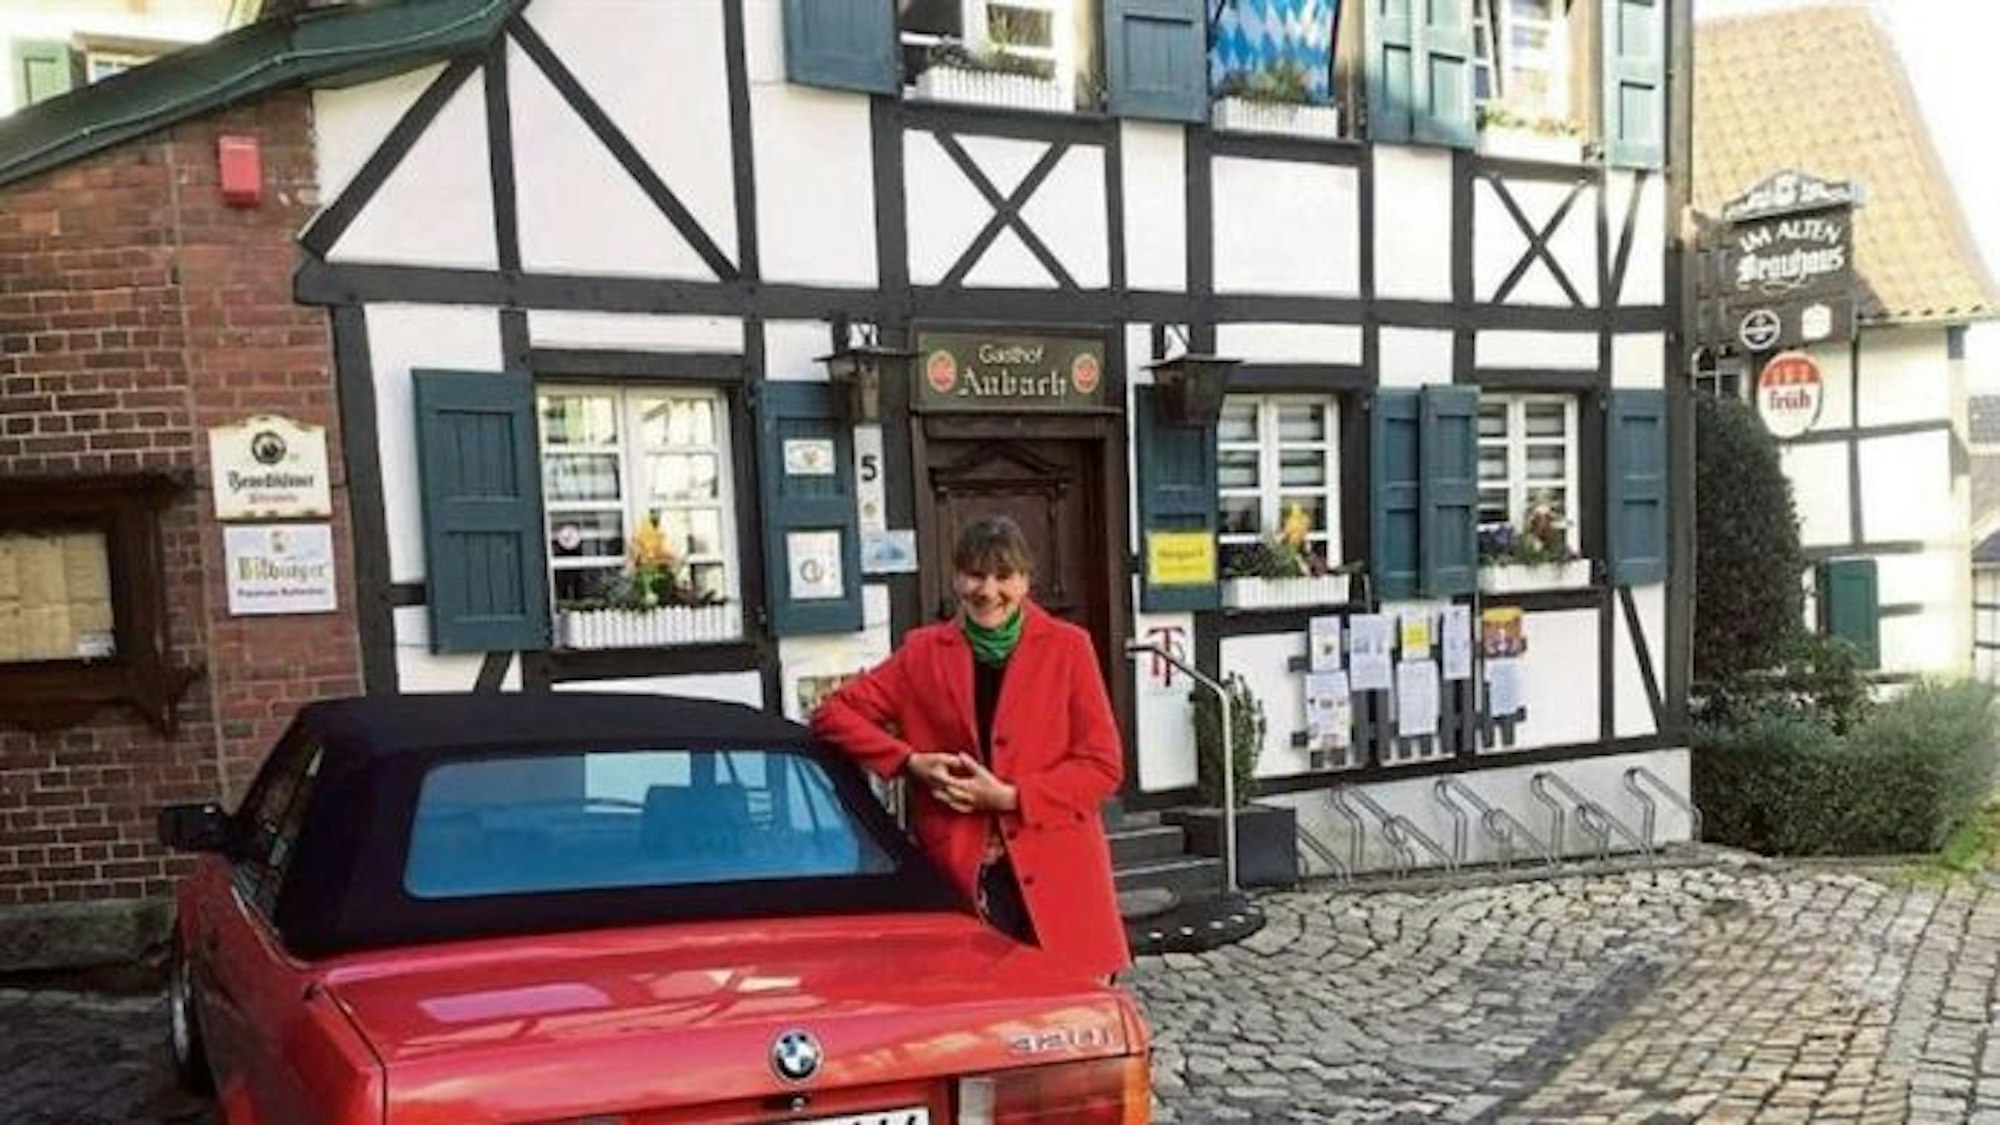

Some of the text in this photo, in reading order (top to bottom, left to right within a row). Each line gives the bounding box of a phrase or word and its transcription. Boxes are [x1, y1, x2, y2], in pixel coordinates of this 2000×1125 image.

[1739, 220, 1842, 252] IM ALTEN
[978, 344, 1044, 364] Gasthof
[957, 366, 1067, 396] Aubach
[861, 455, 877, 481] 5
